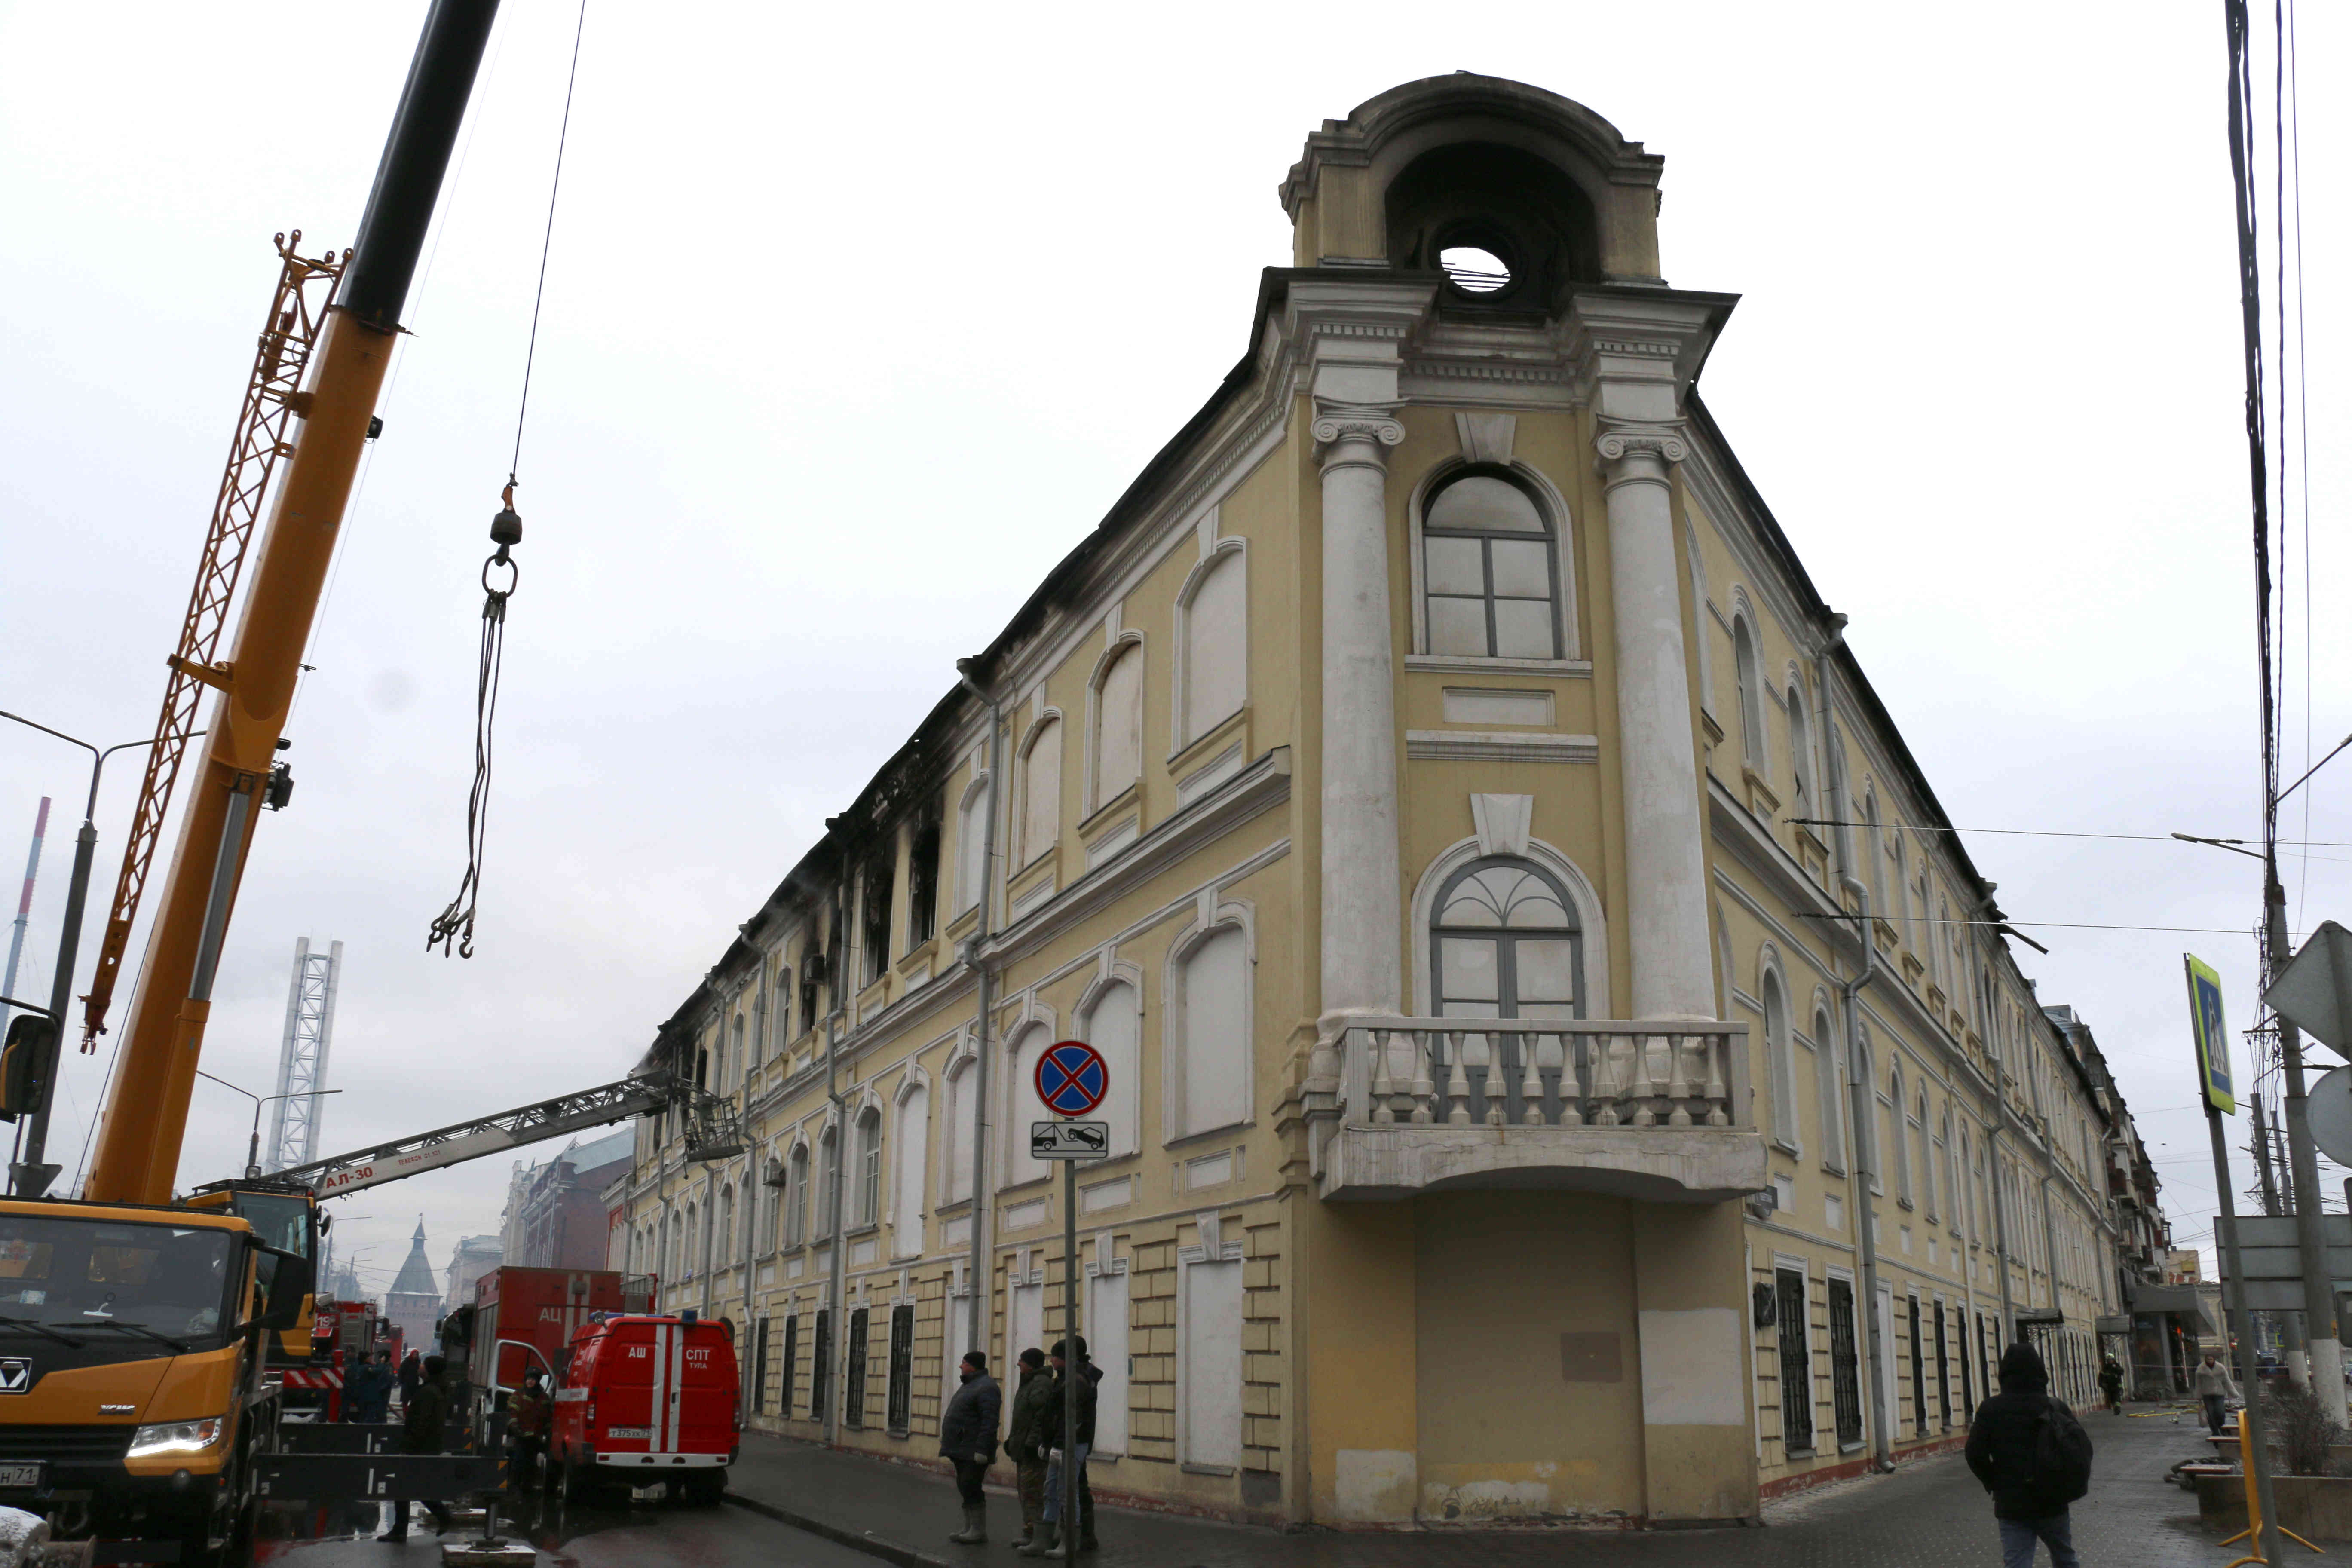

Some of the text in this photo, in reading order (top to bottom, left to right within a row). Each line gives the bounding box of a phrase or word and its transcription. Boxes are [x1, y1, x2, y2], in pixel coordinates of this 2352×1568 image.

[326, 1167, 373, 1189] АЛ-30
[539, 1307, 561, 1324] АЦ
[628, 1347, 646, 1358] АШ
[686, 1349, 711, 1360] СПТ
